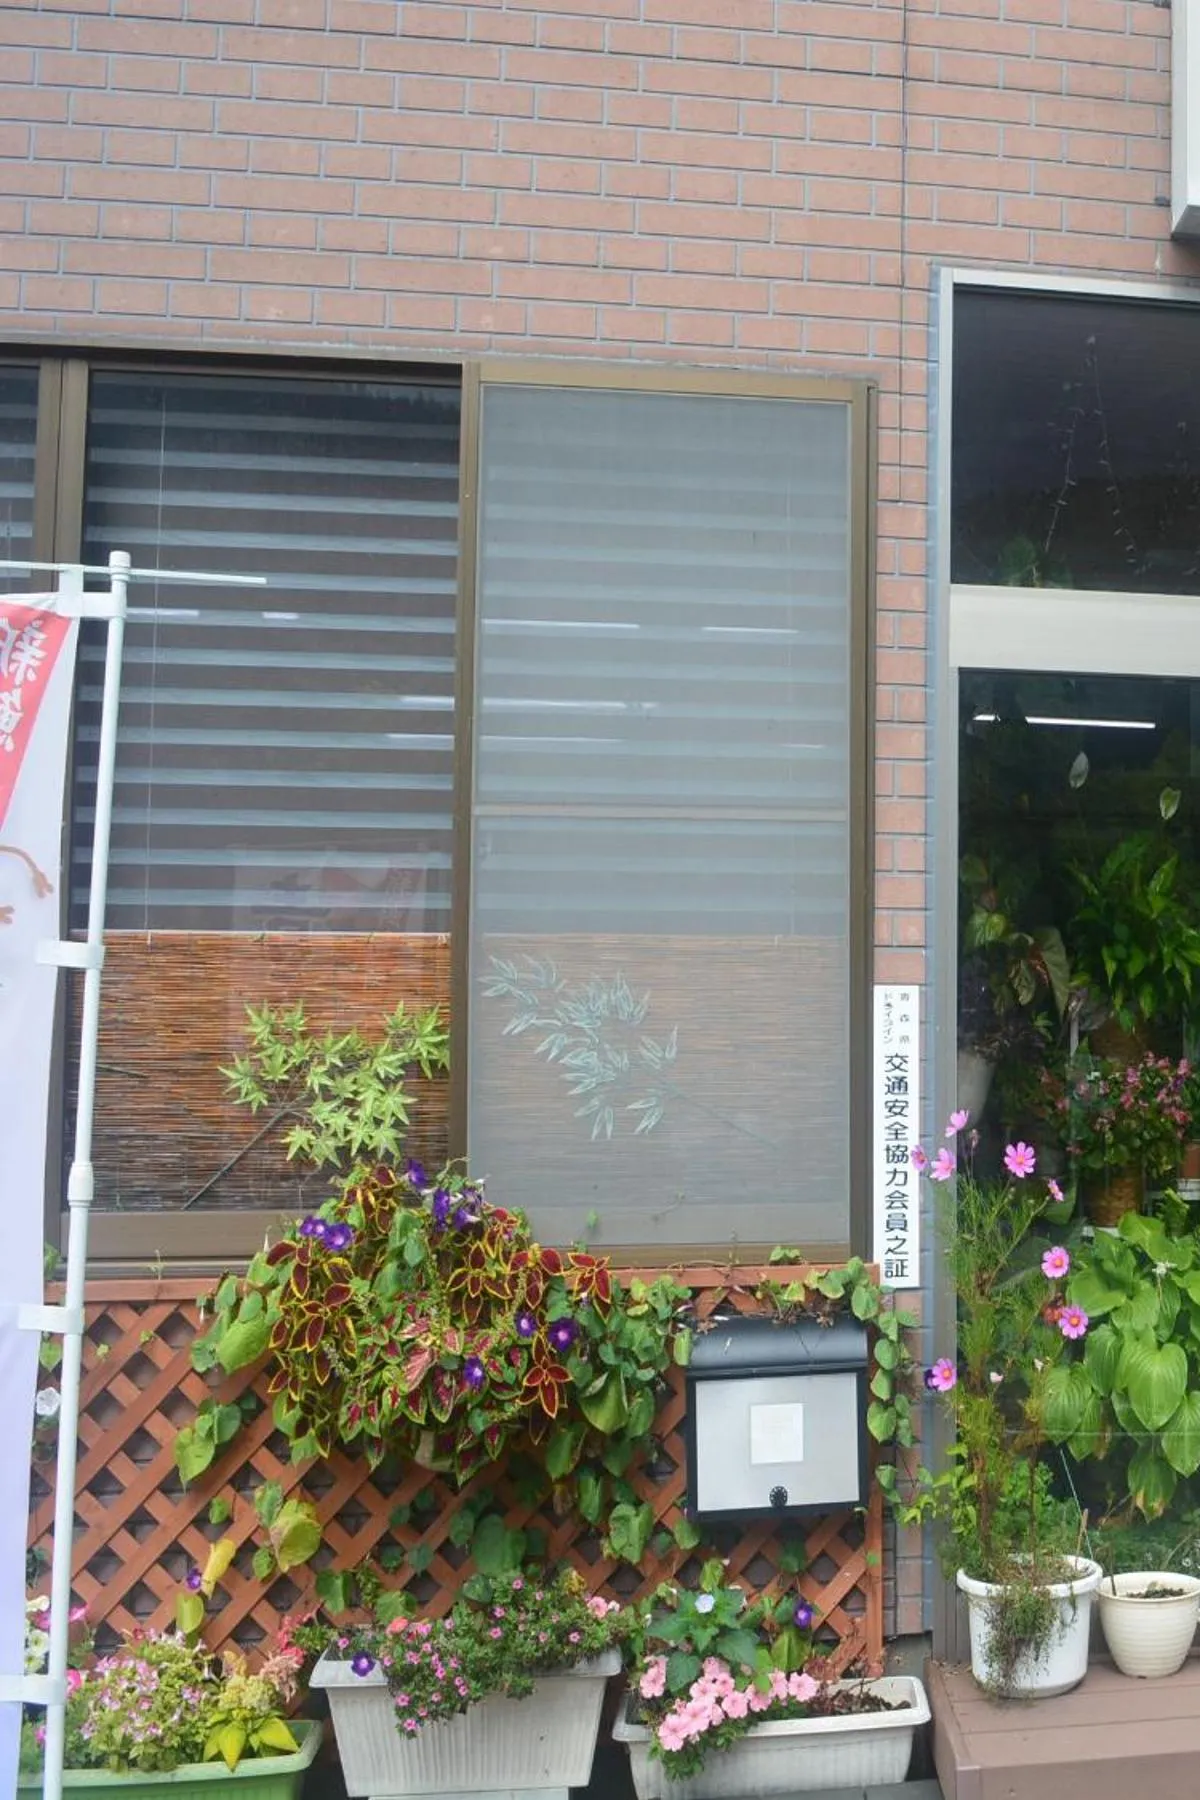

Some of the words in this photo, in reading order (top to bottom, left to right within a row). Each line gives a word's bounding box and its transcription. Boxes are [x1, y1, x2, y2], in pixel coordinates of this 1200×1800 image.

[884, 1052, 910, 1279] 交通安全協力会員之証
